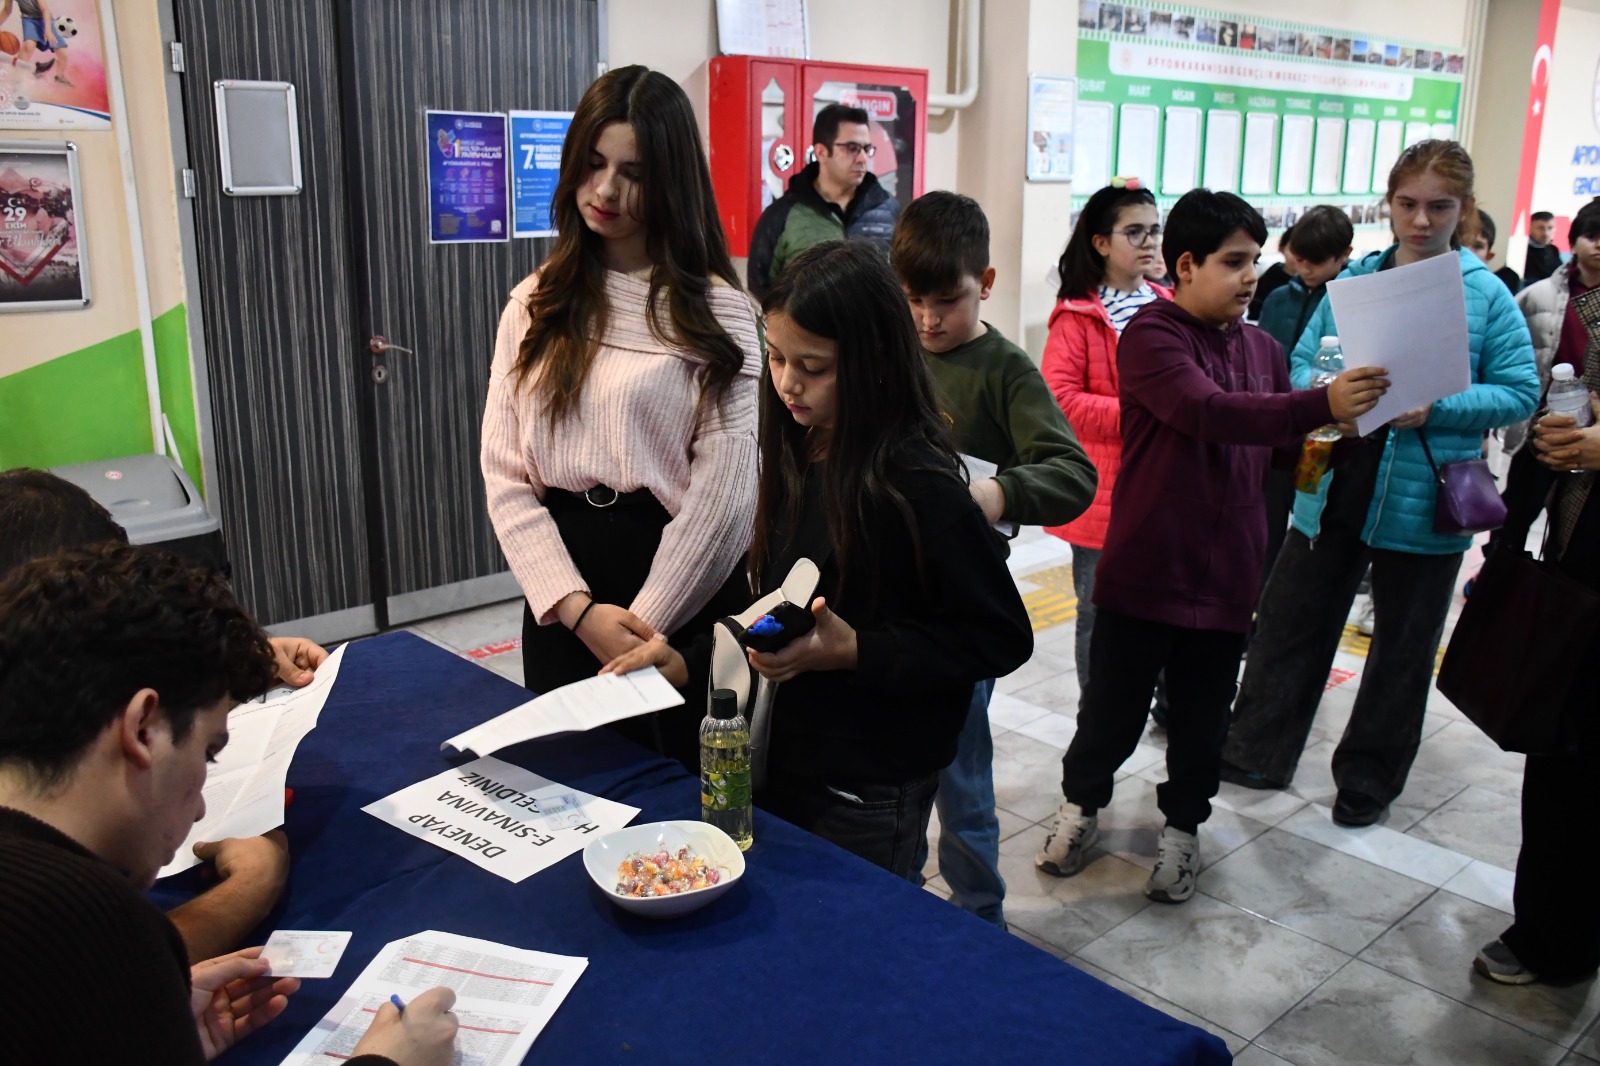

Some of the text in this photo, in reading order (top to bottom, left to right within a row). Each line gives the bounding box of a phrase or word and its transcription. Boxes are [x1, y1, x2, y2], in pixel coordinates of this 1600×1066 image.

[1127, 84, 1152, 98] MART
[1171, 87, 1196, 102] NİSAN
[520, 144, 535, 170] 7.
[3, 206, 27, 222] 29
[5, 222, 27, 230] EKİM
[437, 790, 556, 847] E-SINAVINA
[408, 814, 507, 859] DENEYAP
